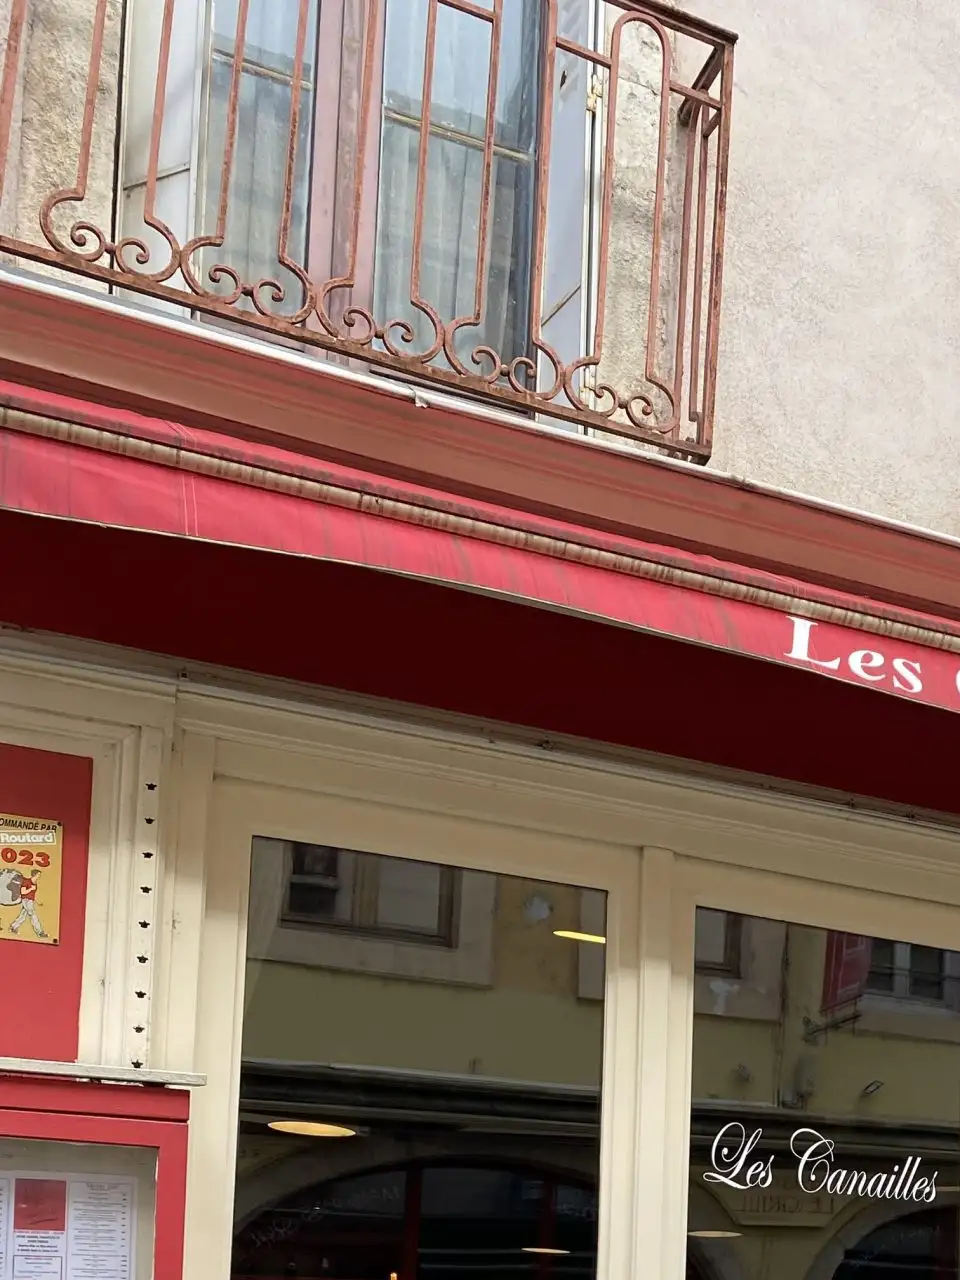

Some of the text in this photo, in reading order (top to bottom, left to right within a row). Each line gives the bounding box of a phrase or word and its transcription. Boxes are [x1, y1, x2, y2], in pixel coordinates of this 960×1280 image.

[783, 616, 923, 693] Les
[40, 823, 57, 833] PAR
[702, 1121, 939, 1203] Les Canailles
